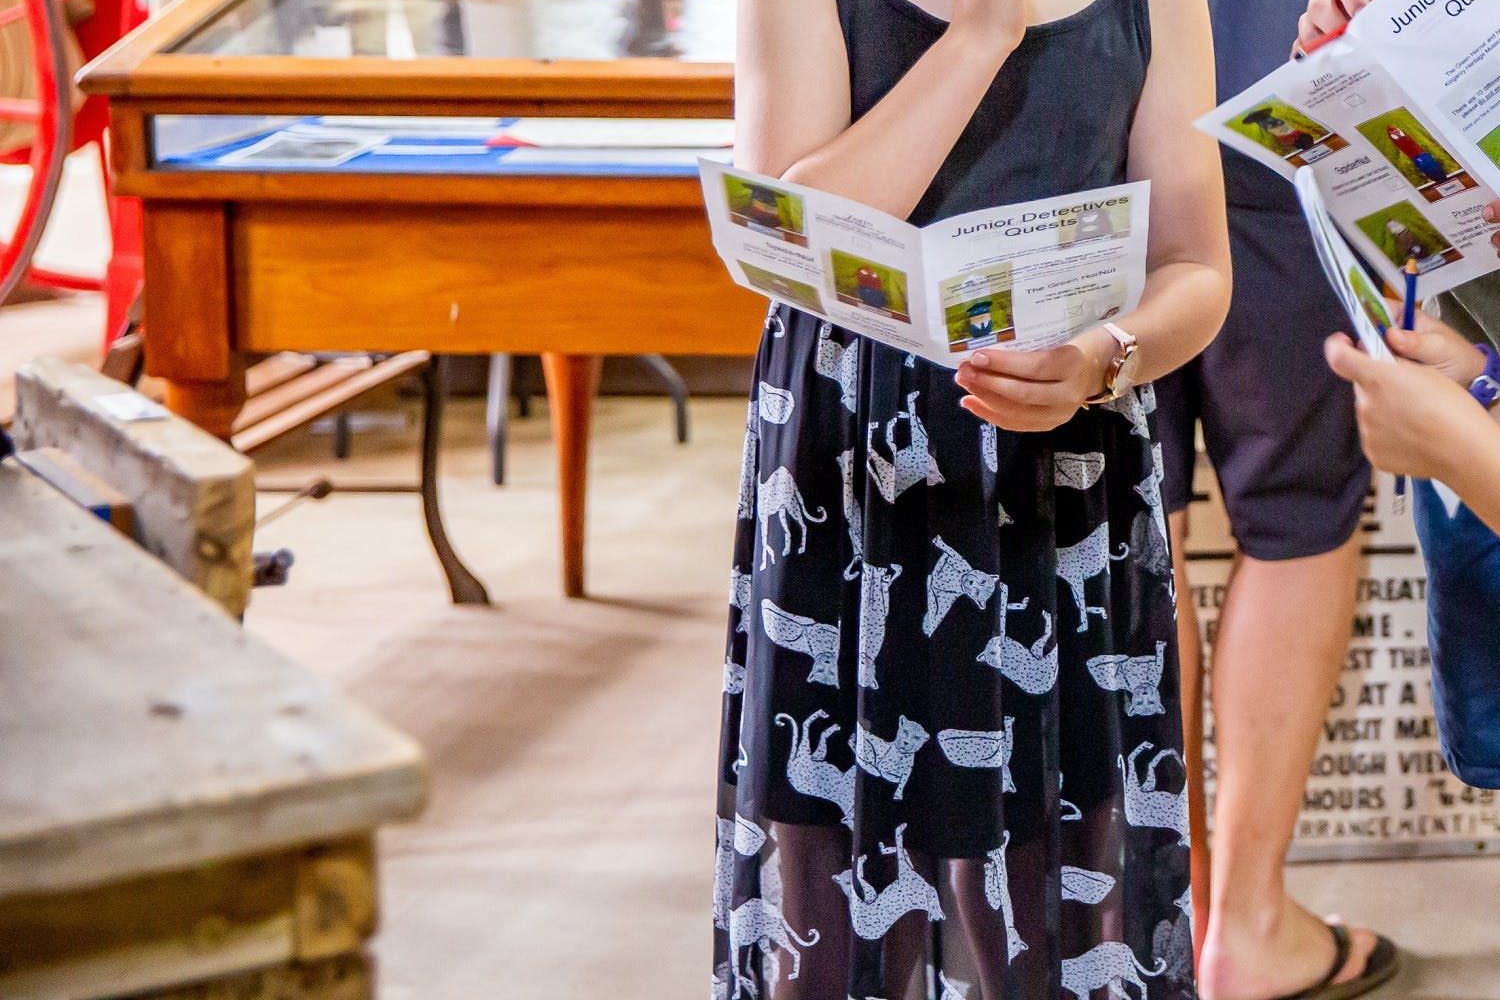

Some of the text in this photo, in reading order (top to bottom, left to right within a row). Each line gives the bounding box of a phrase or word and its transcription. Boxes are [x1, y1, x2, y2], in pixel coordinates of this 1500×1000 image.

[952, 195, 1130, 238] Junior Detectives
[1005, 217, 1078, 237] Quests
[1027, 286, 1045, 294] The
